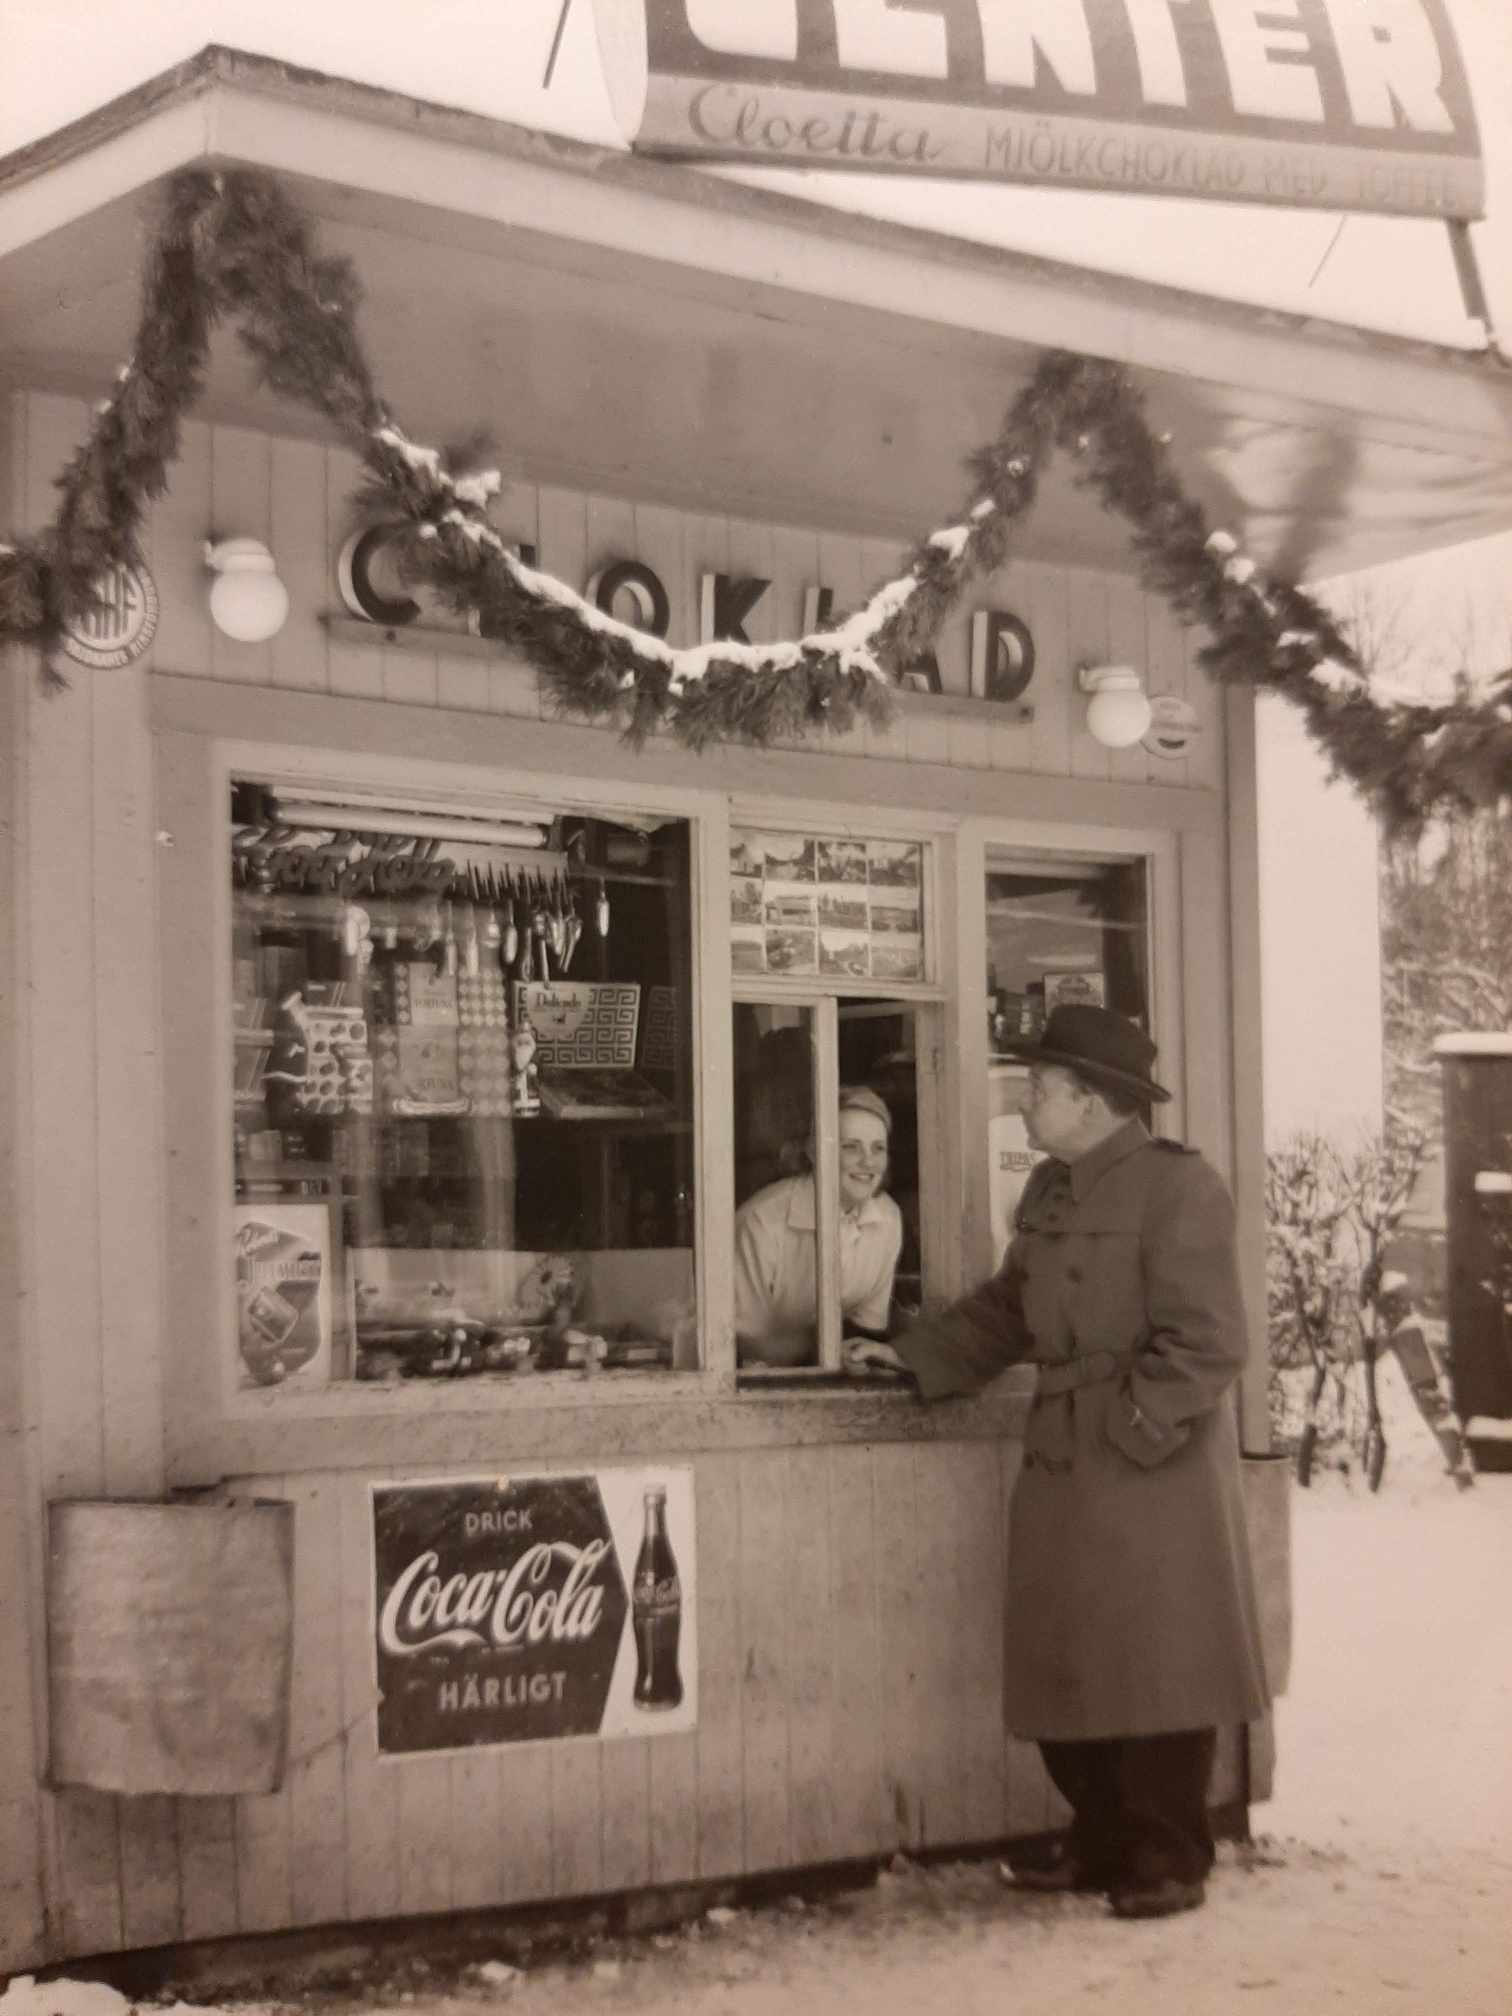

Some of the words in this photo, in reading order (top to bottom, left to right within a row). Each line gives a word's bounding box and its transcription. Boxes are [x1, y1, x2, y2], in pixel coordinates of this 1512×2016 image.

[687, 81, 948, 162] Cloetta
[338, 519, 1036, 704] COKD
[464, 1509, 533, 1536] DRICK
[381, 1538, 614, 1654] Coca-Cola
[438, 1671, 567, 1712] HÄRLIGT
